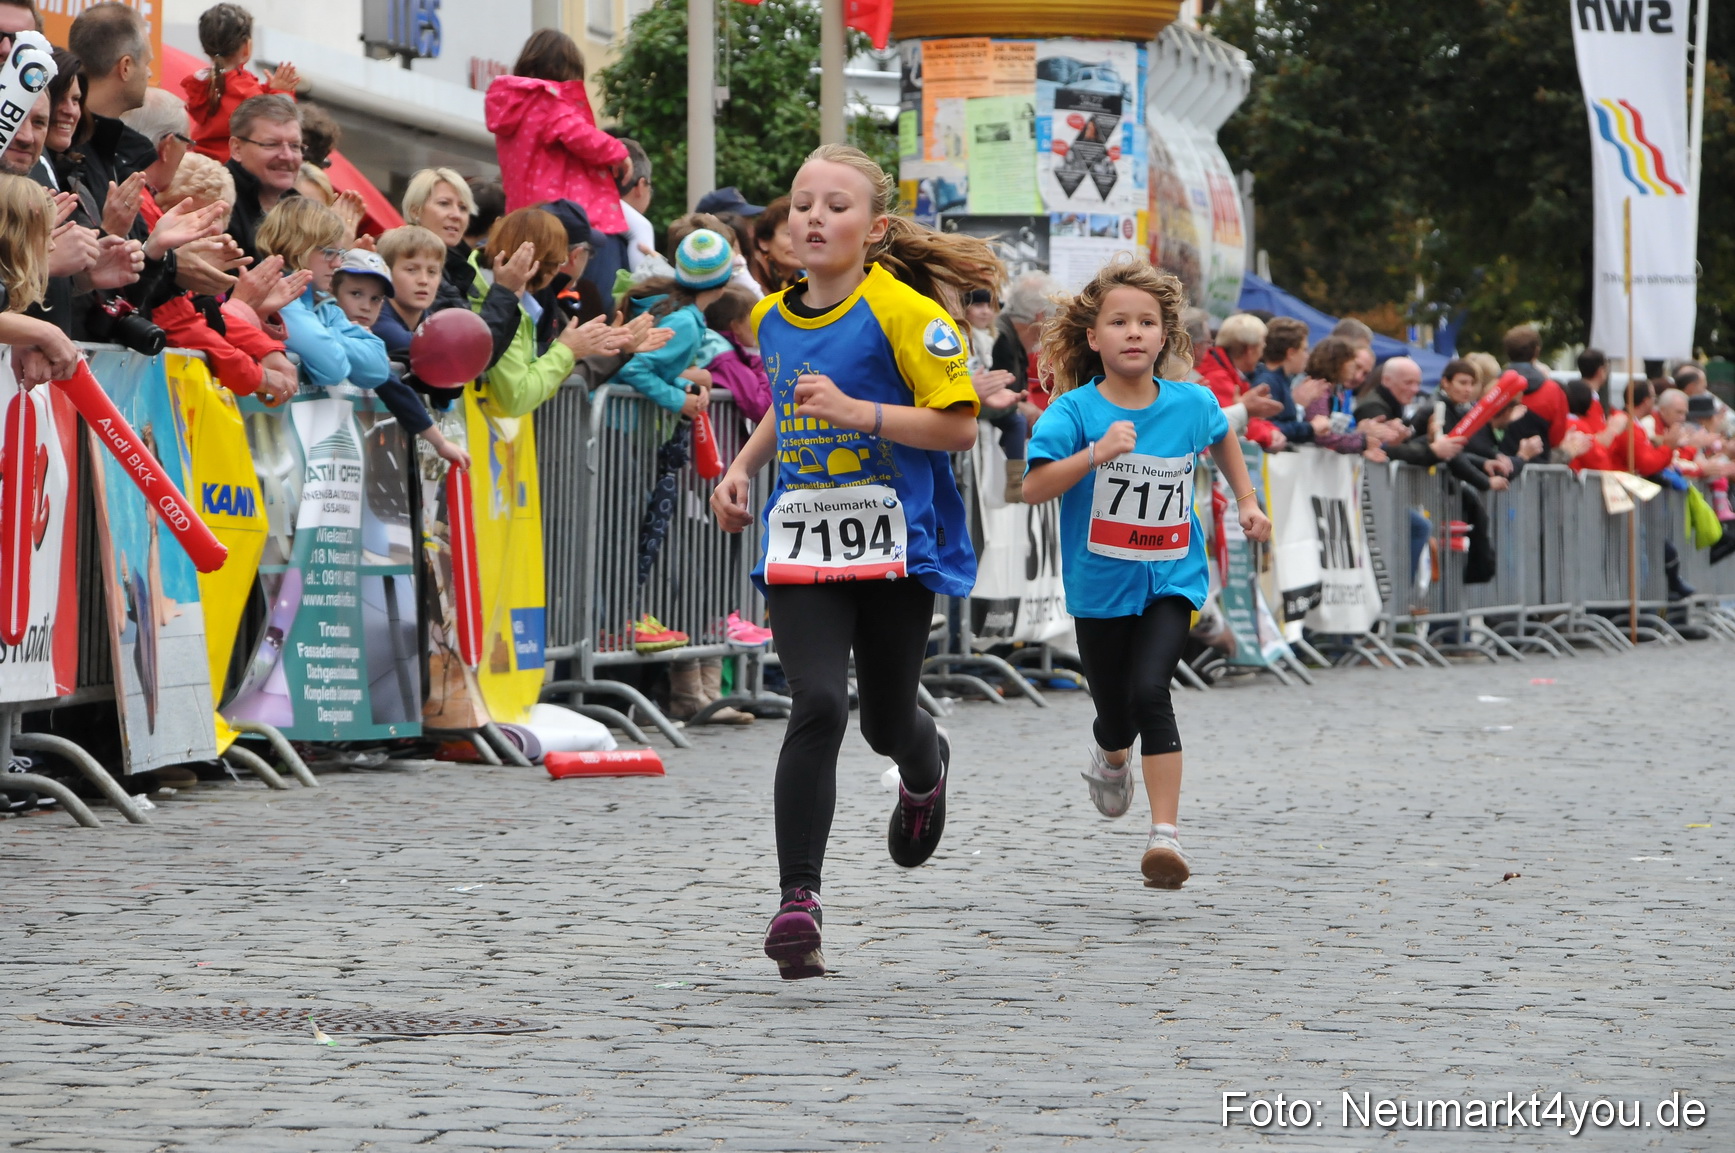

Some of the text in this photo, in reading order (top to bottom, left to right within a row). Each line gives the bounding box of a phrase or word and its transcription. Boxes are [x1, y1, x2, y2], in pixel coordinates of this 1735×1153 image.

[836, 432, 860, 443] 2014
[98, 418, 157, 486] Audi BKK
[1100, 461, 1139, 474] PARTL
[772, 499, 878, 514] PARTL Neumarkt
[1108, 477, 1184, 521] 7171
[782, 514, 896, 562] 7194
[1128, 530, 1164, 546] Anne
